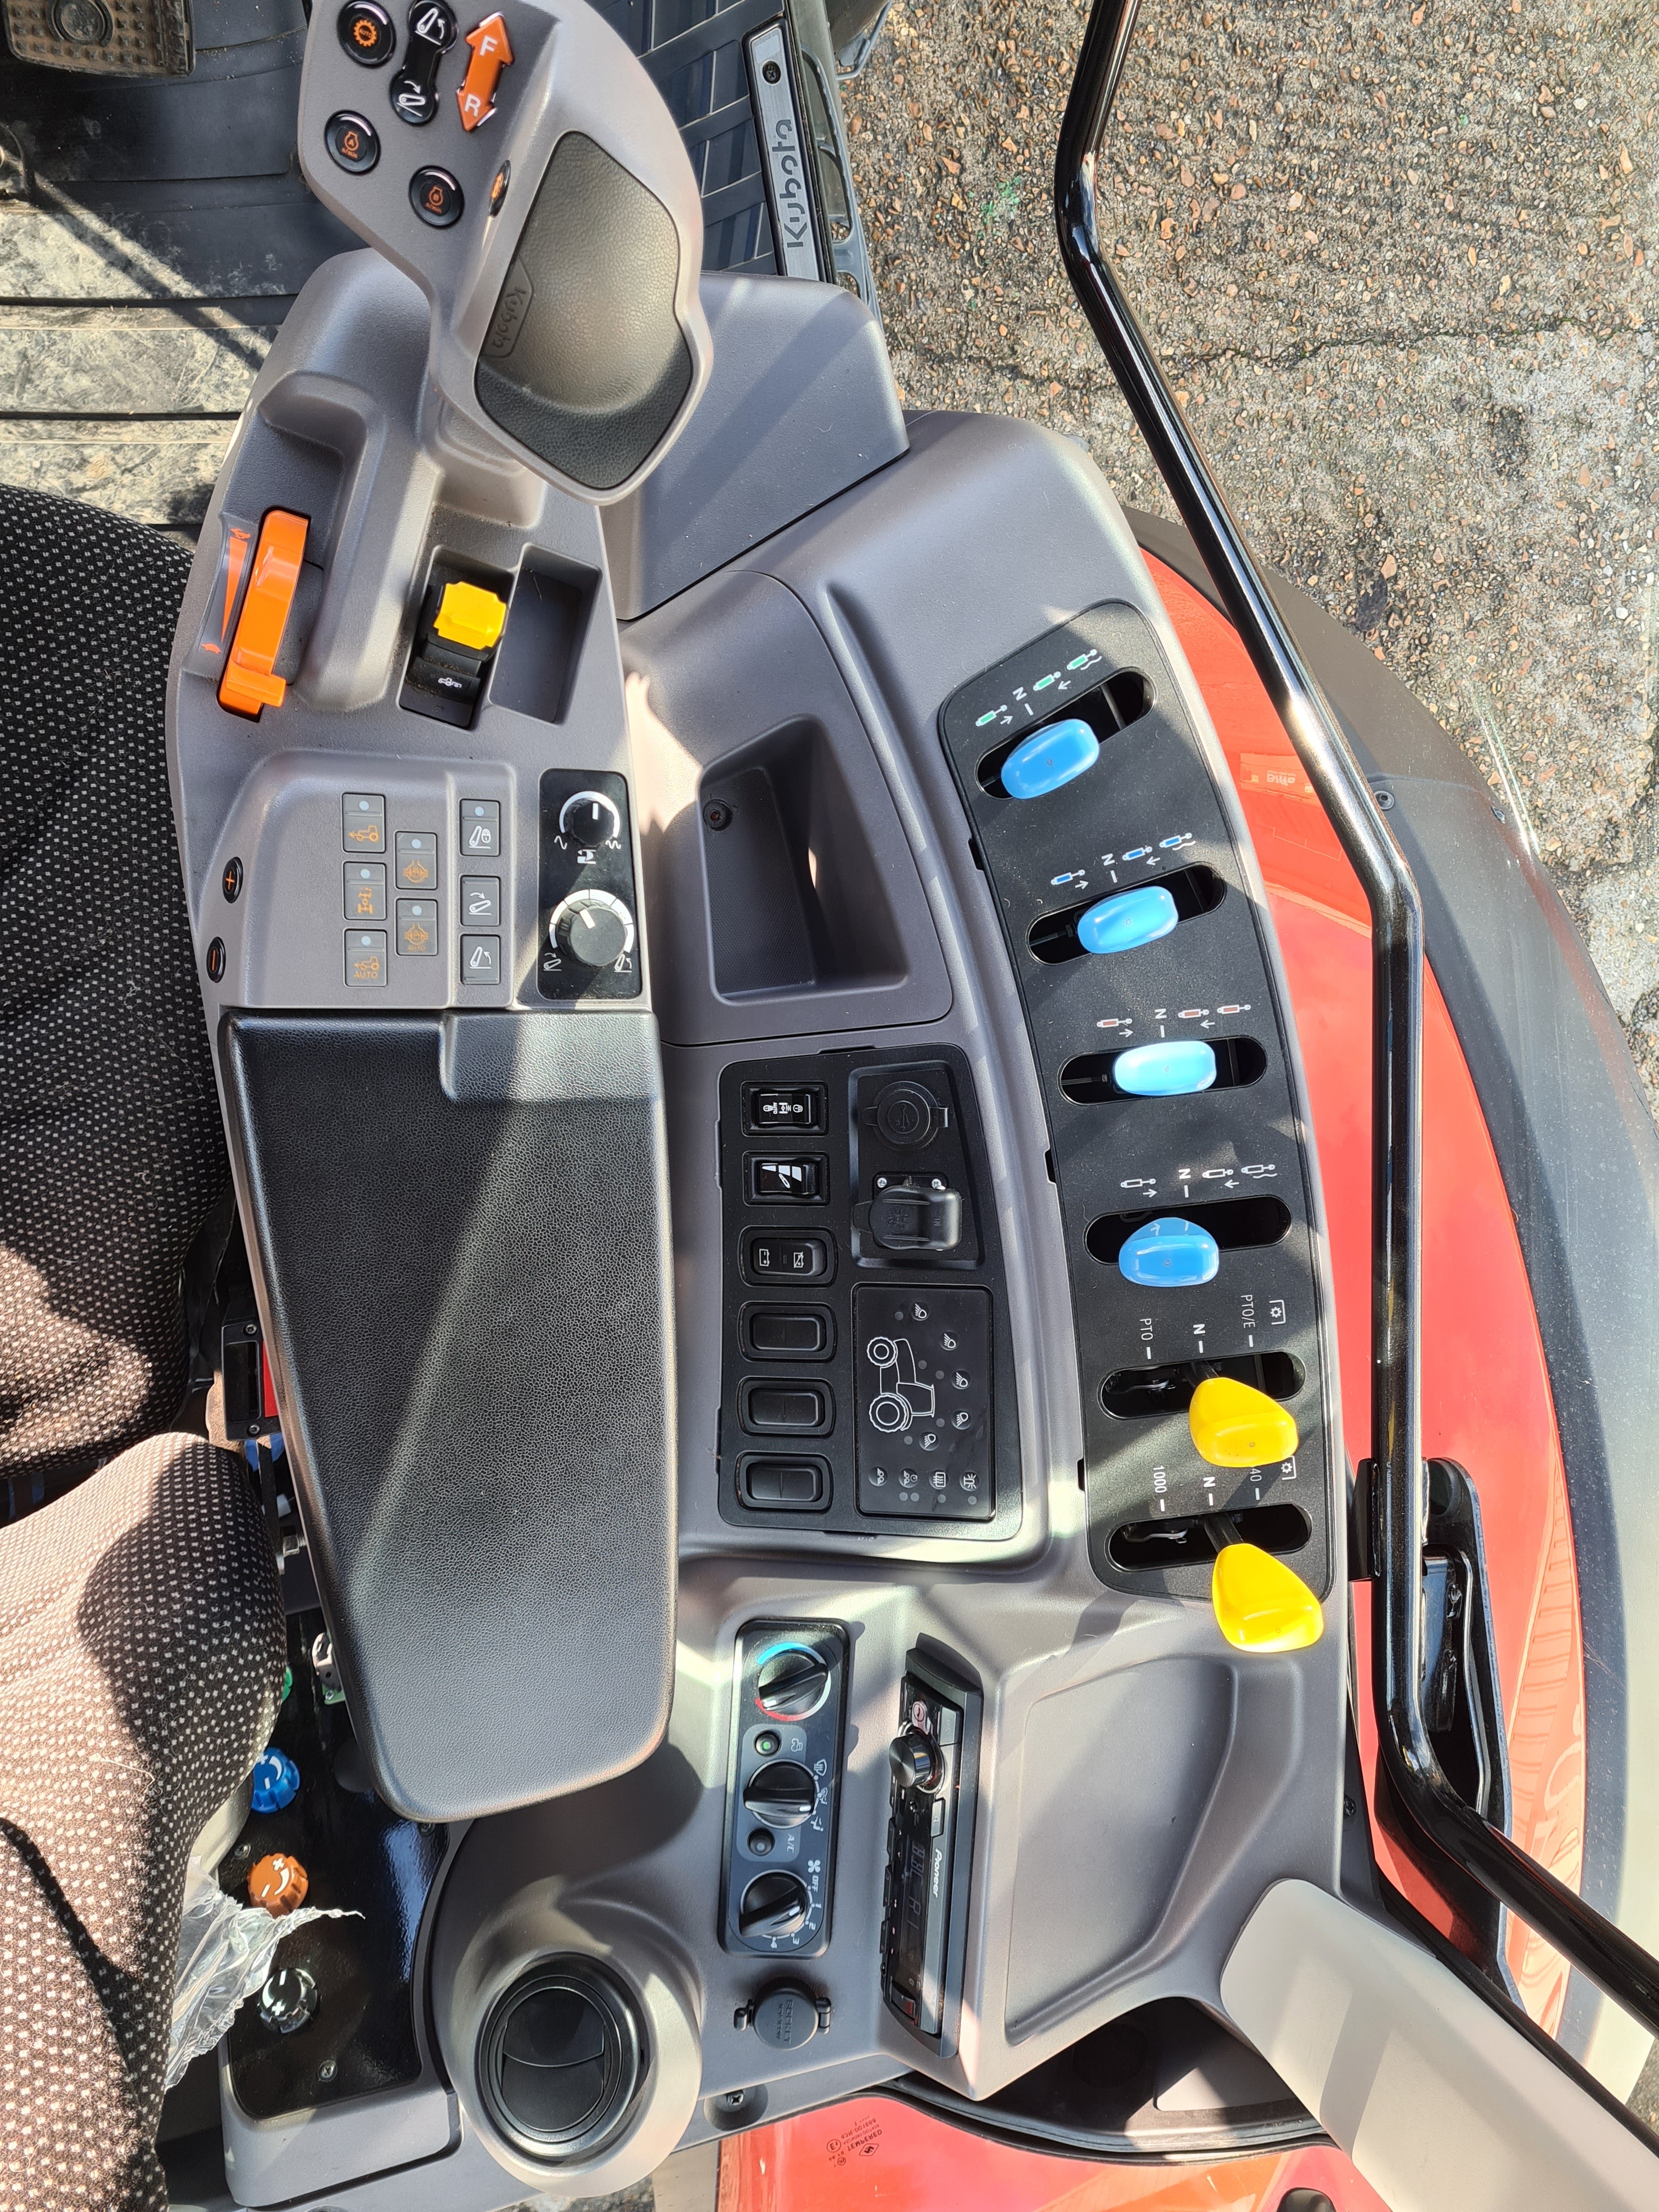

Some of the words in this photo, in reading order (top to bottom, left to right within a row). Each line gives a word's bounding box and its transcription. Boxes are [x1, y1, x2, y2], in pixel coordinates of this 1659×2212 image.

[359, 28, 373, 38] AUTO
[479, 35, 498, 57] F
[464, 93, 481, 117] R
[769, 119, 808, 249] Kubota
[492, 285, 527, 349] Kubota
[1012, 687, 1027, 701] N
[1101, 854, 1115, 866] N
[1154, 1008, 1167, 1019] N
[1179, 1168, 1192, 1180] N
[1240, 1294, 1256, 1329] PTO/E
[1139, 1318, 1153, 1340] PTO
[1193, 1324, 1206, 1335] N
[1153, 1465, 1167, 1493] 1000
[1203, 1476, 1216, 1487] N
[1250, 1466, 1262, 1482] 40
[787, 1833, 795, 1853] A/C
[910, 1841, 926, 1885] BBC
[933, 1848, 942, 1898] Pioneer
[809, 1922, 816, 1931] 2
[792, 1937, 800, 1945] 3
[784, 1999, 794, 2045] SOCKET
